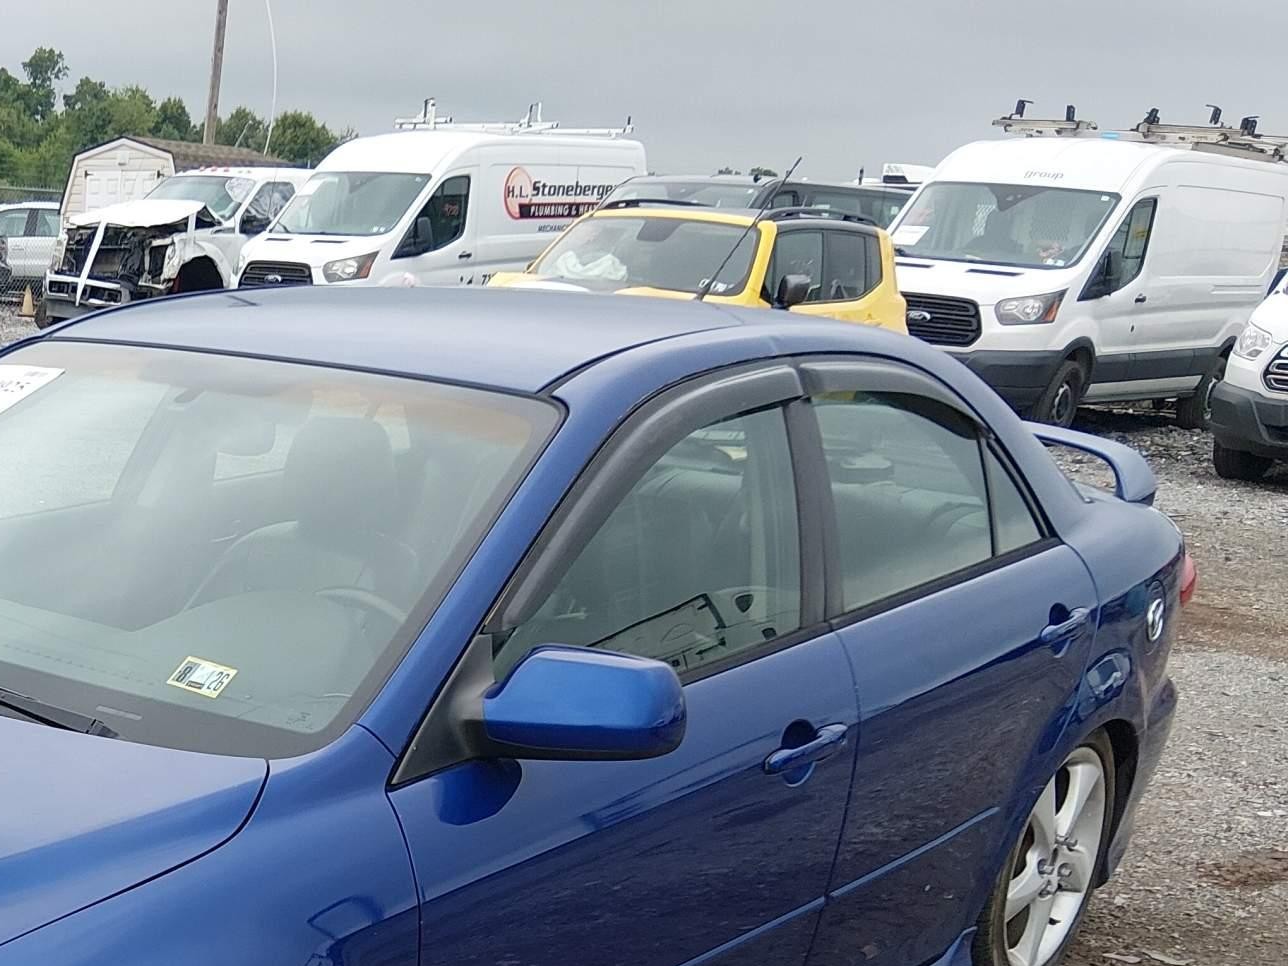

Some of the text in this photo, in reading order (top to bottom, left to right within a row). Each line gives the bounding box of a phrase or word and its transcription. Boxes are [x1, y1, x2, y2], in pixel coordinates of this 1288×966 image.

[507, 180, 616, 200] H.L. Stoneberge
[530, 203, 570, 217] PLUMBING
[206, 671, 231, 692] 26
